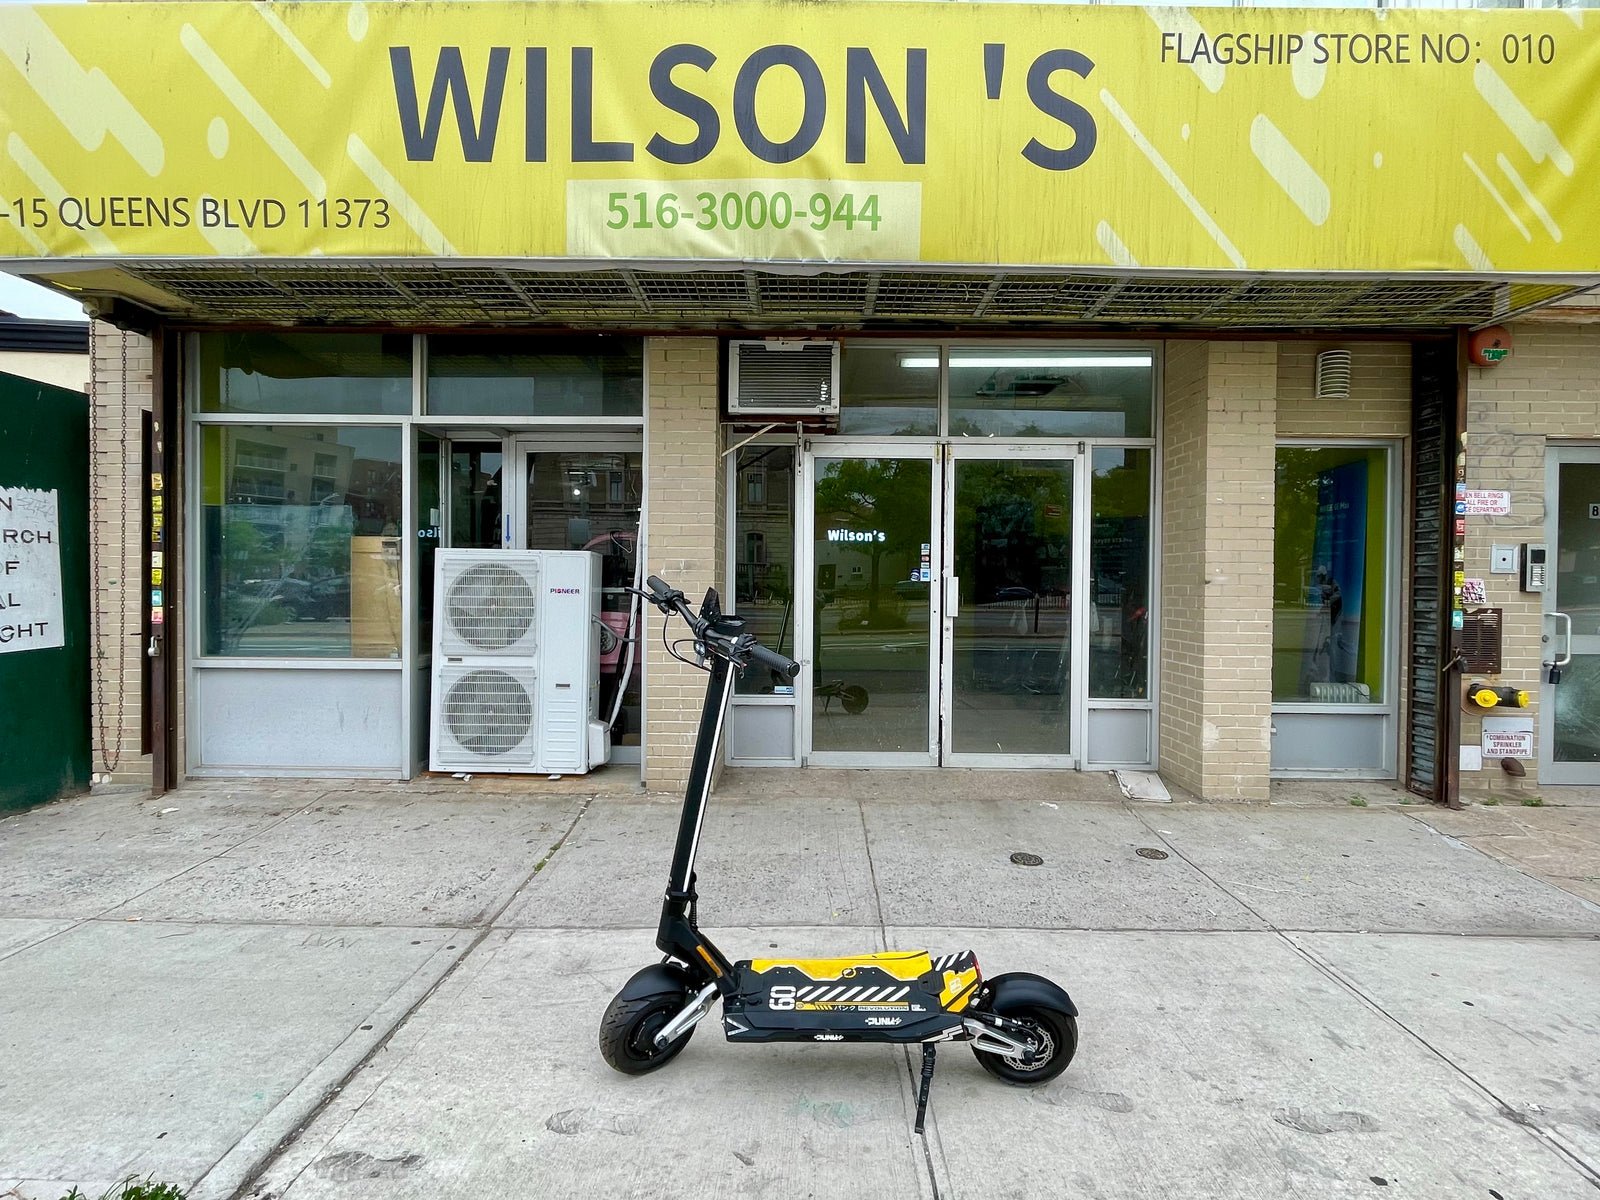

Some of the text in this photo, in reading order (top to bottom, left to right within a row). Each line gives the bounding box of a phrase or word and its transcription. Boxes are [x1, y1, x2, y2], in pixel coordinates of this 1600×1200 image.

[1161, 31, 1556, 65] FLAGSHIP STORE NO: 010
[389, 42, 1098, 171] WILSON 'S
[58, 197, 190, 230] QUEENS
[202, 198, 286, 229] BLVD
[299, 198, 391, 229] 11373
[606, 190, 882, 232] 516-3000-944
[3, 529, 52, 544] RCH
[827, 529, 886, 541] Wilson's
